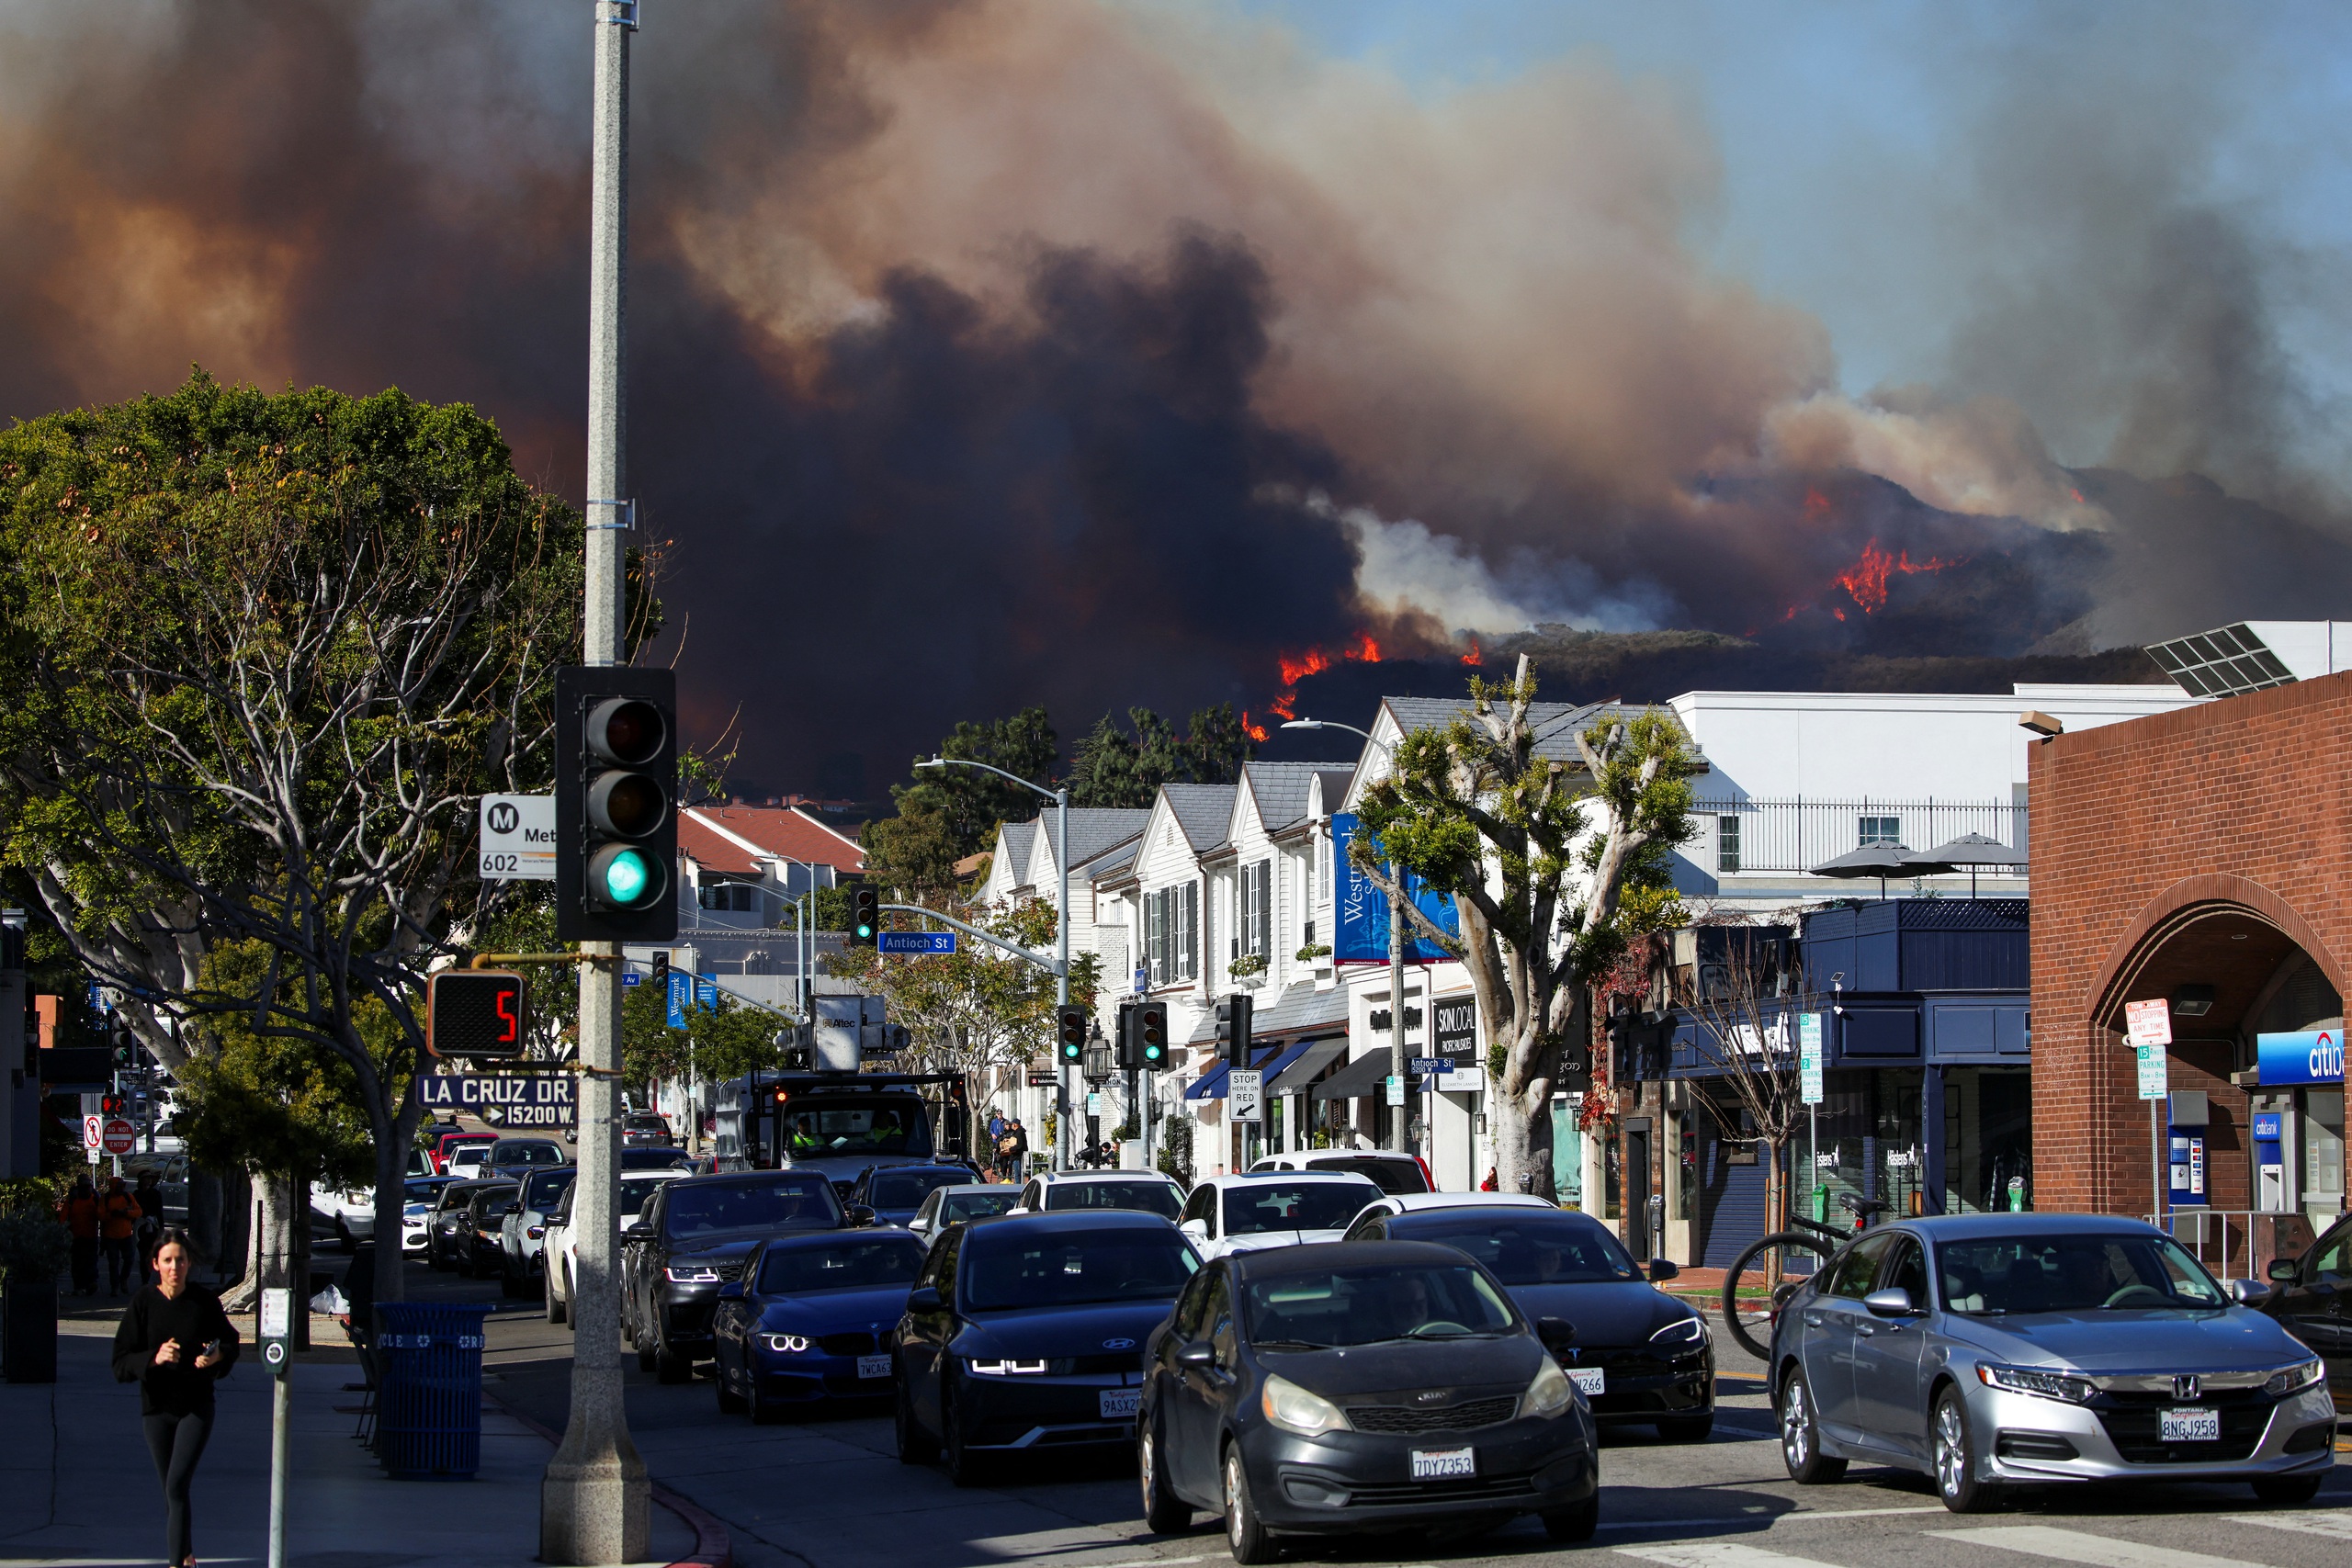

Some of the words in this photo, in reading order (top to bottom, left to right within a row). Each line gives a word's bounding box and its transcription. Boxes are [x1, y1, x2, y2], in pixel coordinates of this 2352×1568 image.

[483, 854, 517, 872] 602
[886, 938, 931, 949] Antioch
[935, 938, 948, 949] St
[671, 977, 680, 1017] Westmark
[497, 991, 516, 1042] 5
[1802, 1015, 1808, 1023] 15
[2128, 1010, 2140, 1022] NO
[2141, 1009, 2166, 1020] STOPPING
[833, 1019, 855, 1028] Altec
[2133, 1023, 2146, 1032] ANY
[2150, 1021, 2165, 1030] TIME
[1802, 1026, 1820, 1034] PARKING
[2140, 1048, 2149, 1057] 15
[1411, 1059, 1438, 1067] Antioch
[1443, 1059, 1452, 1067] St
[2140, 1060, 2165, 1069] PARKING
[424, 1079, 453, 1102] LA
[462, 1079, 526, 1102] CRUZ
[537, 1080, 574, 1102] DR.
[116, 1100, 121, 1111] 2
[508, 1106, 555, 1123] 15200
[559, 1106, 574, 1123] W.
[2256, 1121, 2278, 1134] citibank
[1423, 1392, 1442, 1400] KIA
[2163, 1420, 2216, 1436] 8NGJ958
[1415, 1457, 1471, 1476] 7DYZ353
